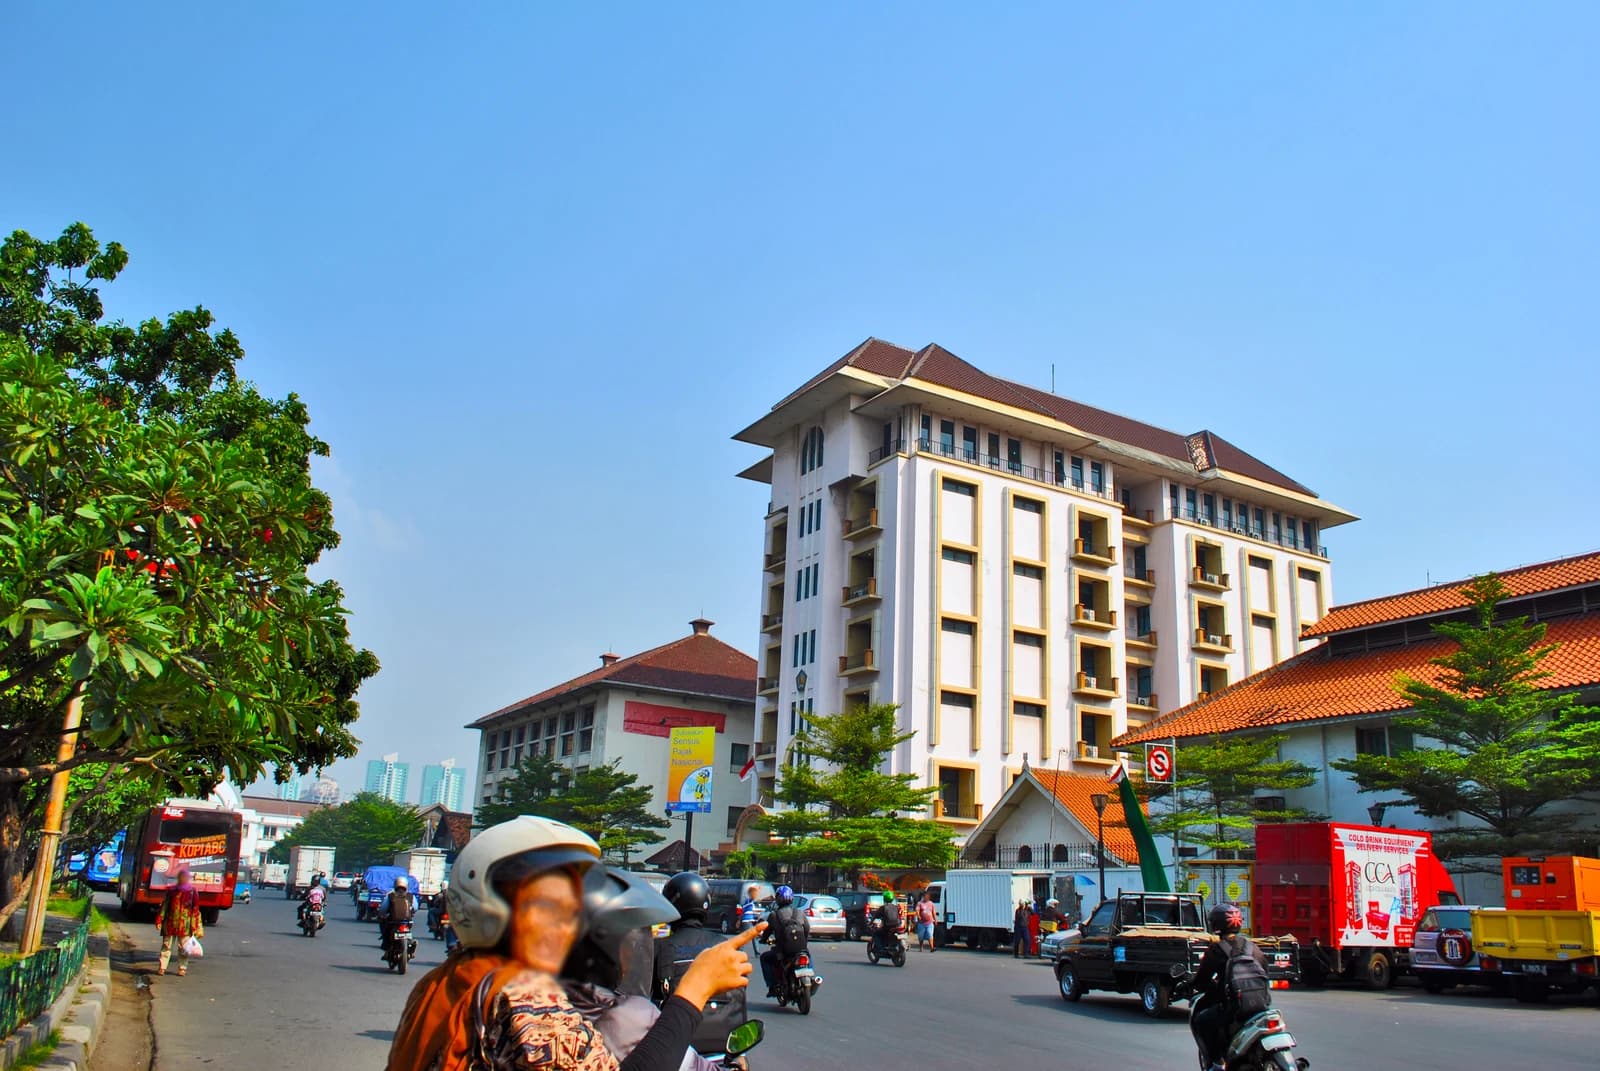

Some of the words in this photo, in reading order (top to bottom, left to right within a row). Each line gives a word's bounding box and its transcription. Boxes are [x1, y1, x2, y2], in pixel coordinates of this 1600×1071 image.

[673, 737, 700, 745] Sensus
[164, 807, 185, 817] ABC
[1348, 834, 1364, 842] COLD
[1365, 835, 1383, 844] DRINK
[1384, 837, 1415, 848] EQUIPMENT
[179, 843, 204, 858] KOPI
[204, 840, 226, 856] ABC
[1356, 843, 1383, 852] DELIVERY
[1383, 845, 1409, 855] SERVICES
[1364, 861, 1395, 884] CCA
